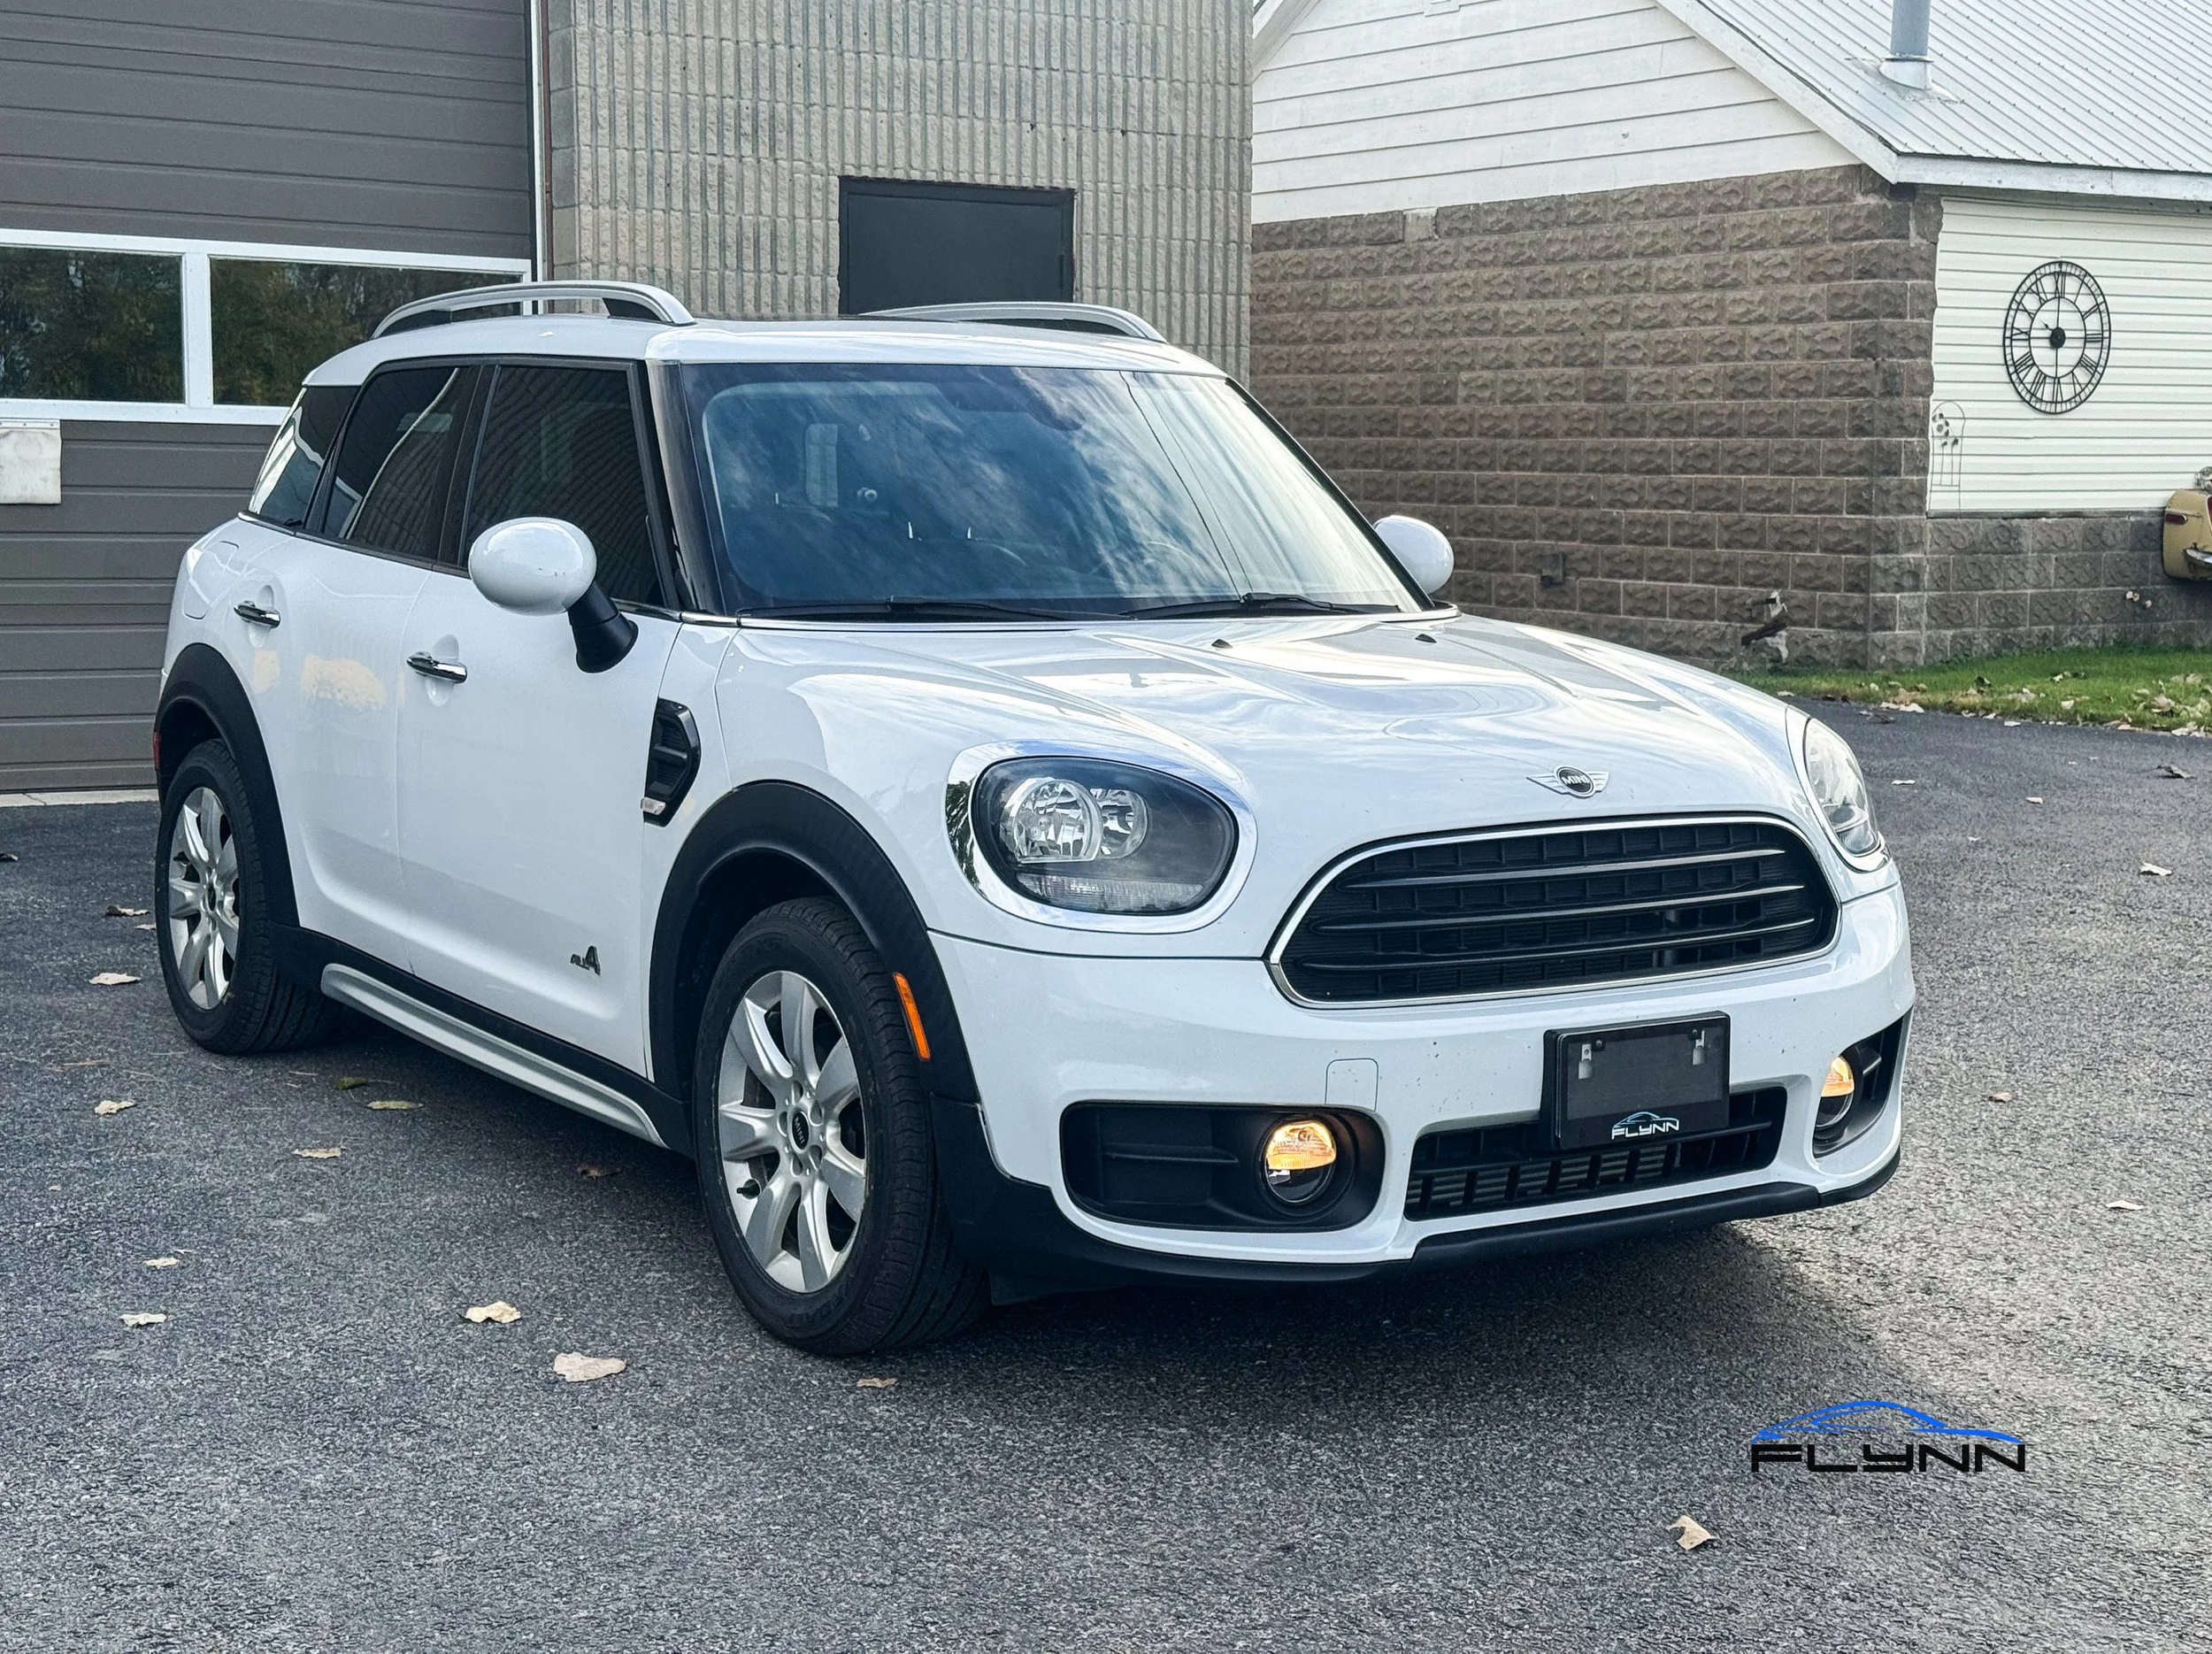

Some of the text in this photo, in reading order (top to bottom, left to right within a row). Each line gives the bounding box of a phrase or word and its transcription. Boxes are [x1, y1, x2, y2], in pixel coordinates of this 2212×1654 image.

[1561, 774, 1590, 785] MINI
[795, 1116, 805, 1144] MINI
[1611, 1119, 1679, 1140] FLYNN
